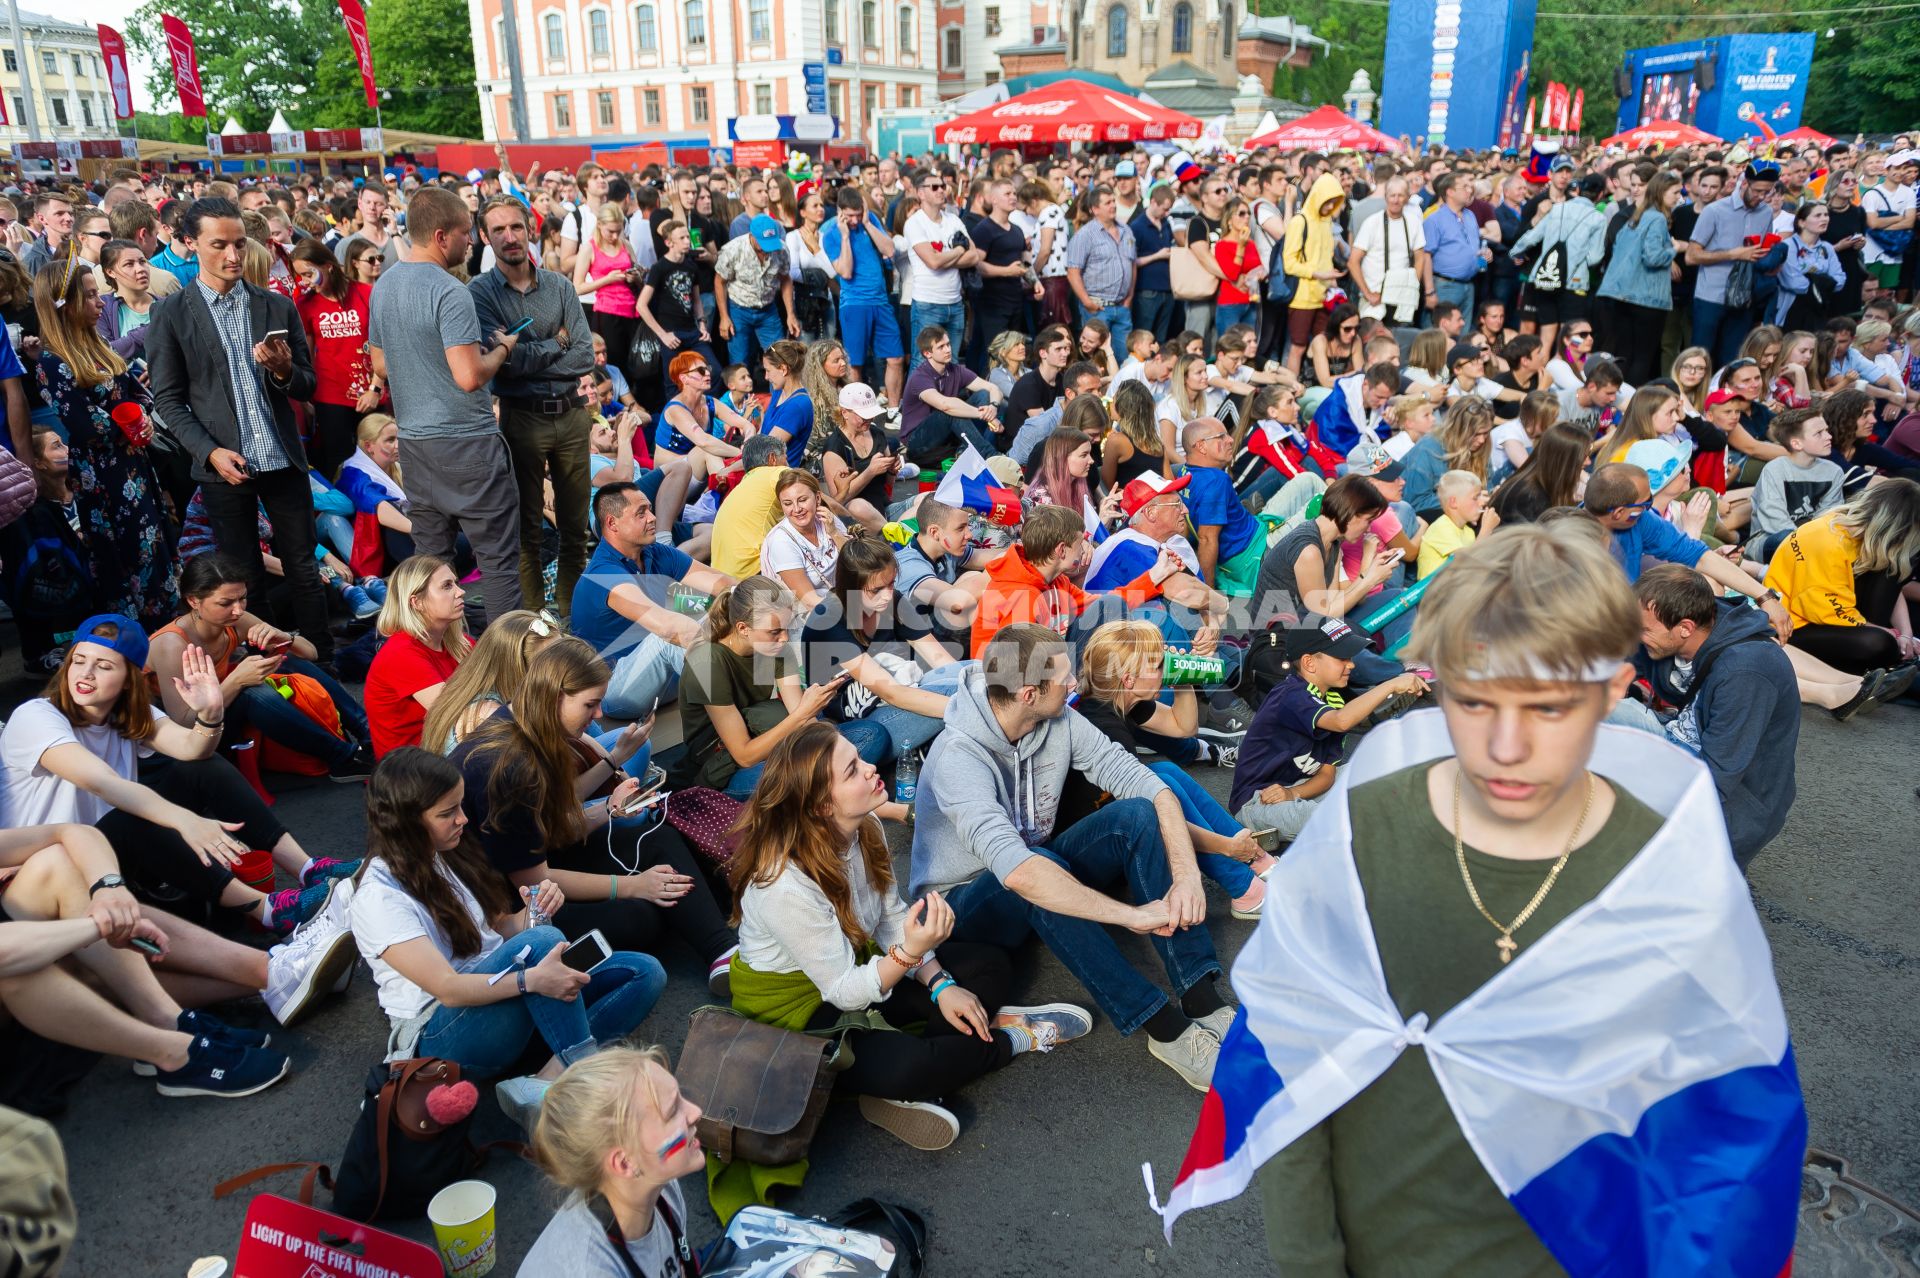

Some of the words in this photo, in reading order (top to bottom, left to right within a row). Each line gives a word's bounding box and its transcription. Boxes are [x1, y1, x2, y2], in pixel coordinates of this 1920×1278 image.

[176, 50, 193, 87] Bud
[998, 124, 1033, 141] Coca-Cola
[1057, 123, 1094, 140] Coca-Cola
[318, 309, 360, 326] 2018
[320, 327, 362, 339] RUSSIA
[1790, 541, 1805, 562] 2017
[1173, 658, 1222, 673] КЛИНСКОЕ
[250, 1221, 285, 1248] LIGHT
[285, 1235, 302, 1254] UP
[303, 1241, 326, 1264] THE
[327, 1251, 353, 1273] FIFA
[355, 1257, 400, 1278] WORLD
